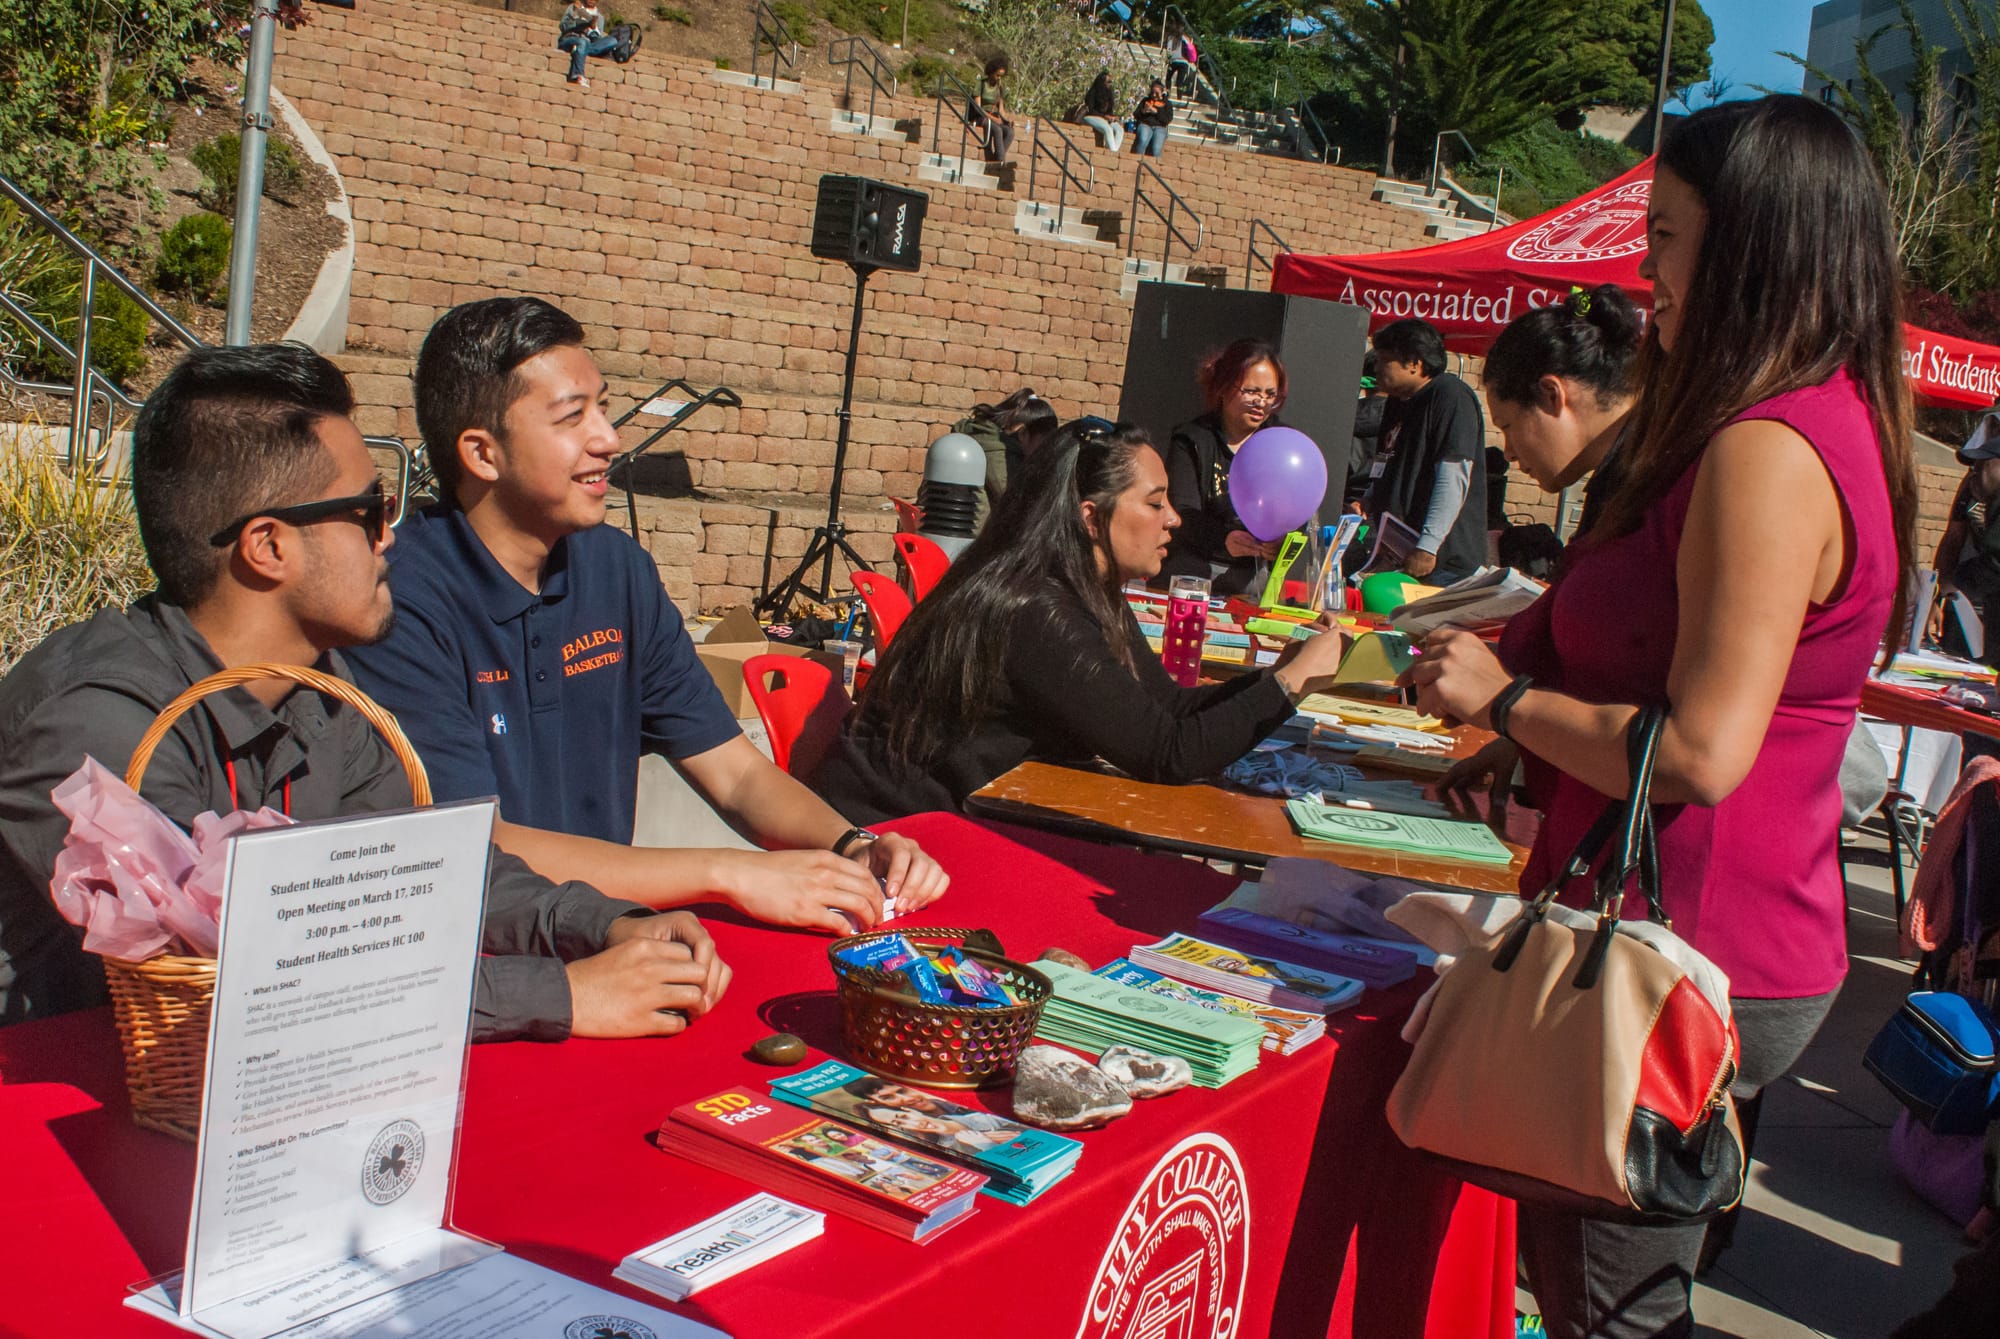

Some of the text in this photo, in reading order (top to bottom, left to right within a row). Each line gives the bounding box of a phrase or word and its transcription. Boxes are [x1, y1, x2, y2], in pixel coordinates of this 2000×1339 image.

[892, 203, 907, 255] RAMSA
[1534, 239, 1648, 260] FRANCIS
[1338, 276, 1513, 325] Associated
[1927, 344, 2000, 397] Students
[329, 841, 396, 862] Come Join the
[270, 857, 444, 896] Student Health Advisory Committee!
[276, 905, 304, 922] Open
[306, 897, 347, 917] Meeting
[347, 898, 360, 908] on
[362, 890, 392, 905] March
[409, 882, 433, 896] 2015
[305, 925, 328, 939] 3:00
[360, 915, 382, 929] 4:00
[275, 930, 425, 970] Student Health Services HC 100
[695, 1093, 752, 1117] STD
[717, 1104, 772, 1126] Facts
[1093, 1193, 1150, 1323] CITY
[1157, 1151, 1242, 1243] COLLEGE
[1112, 1209, 1220, 1331] THE TRUTH SHALL MAKE YOU FREE
